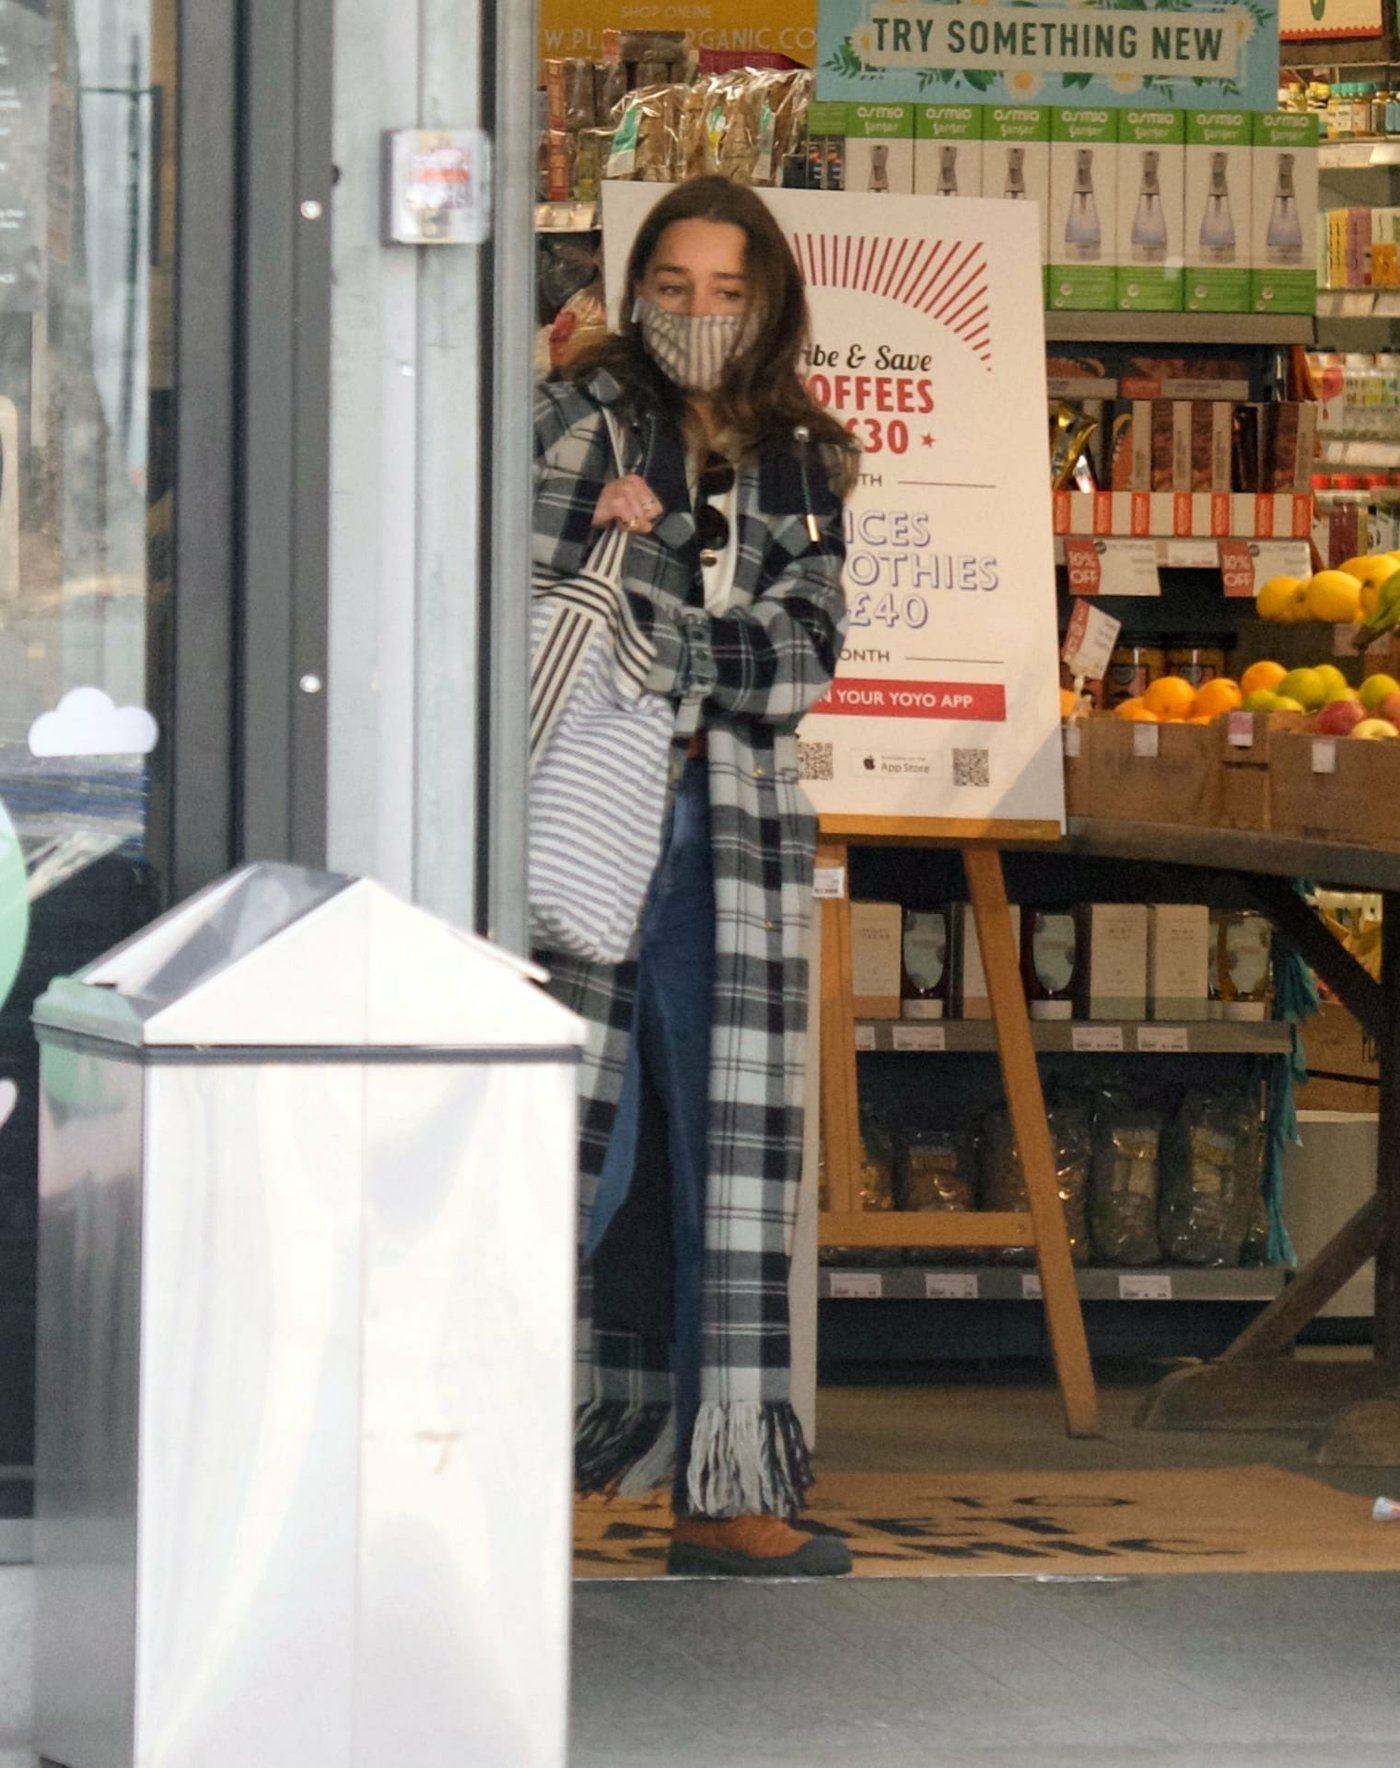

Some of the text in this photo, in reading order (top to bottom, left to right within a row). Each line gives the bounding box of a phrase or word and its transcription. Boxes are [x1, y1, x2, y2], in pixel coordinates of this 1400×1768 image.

[872, 17, 1223, 62] TRY SOMETHING NEW
[846, 344, 866, 369] &
[875, 345, 932, 372] Save
[806, 373, 934, 414] OFFEES
[859, 473, 882, 487] TH
[845, 509, 932, 548] ICES
[848, 550, 999, 592] OTHIES
[847, 591, 929, 629] £40
[839, 649, 890, 662] ONTH
[836, 690, 884, 705] YOUR
[889, 691, 936, 707] YOYO
[940, 694, 973, 708] APP
